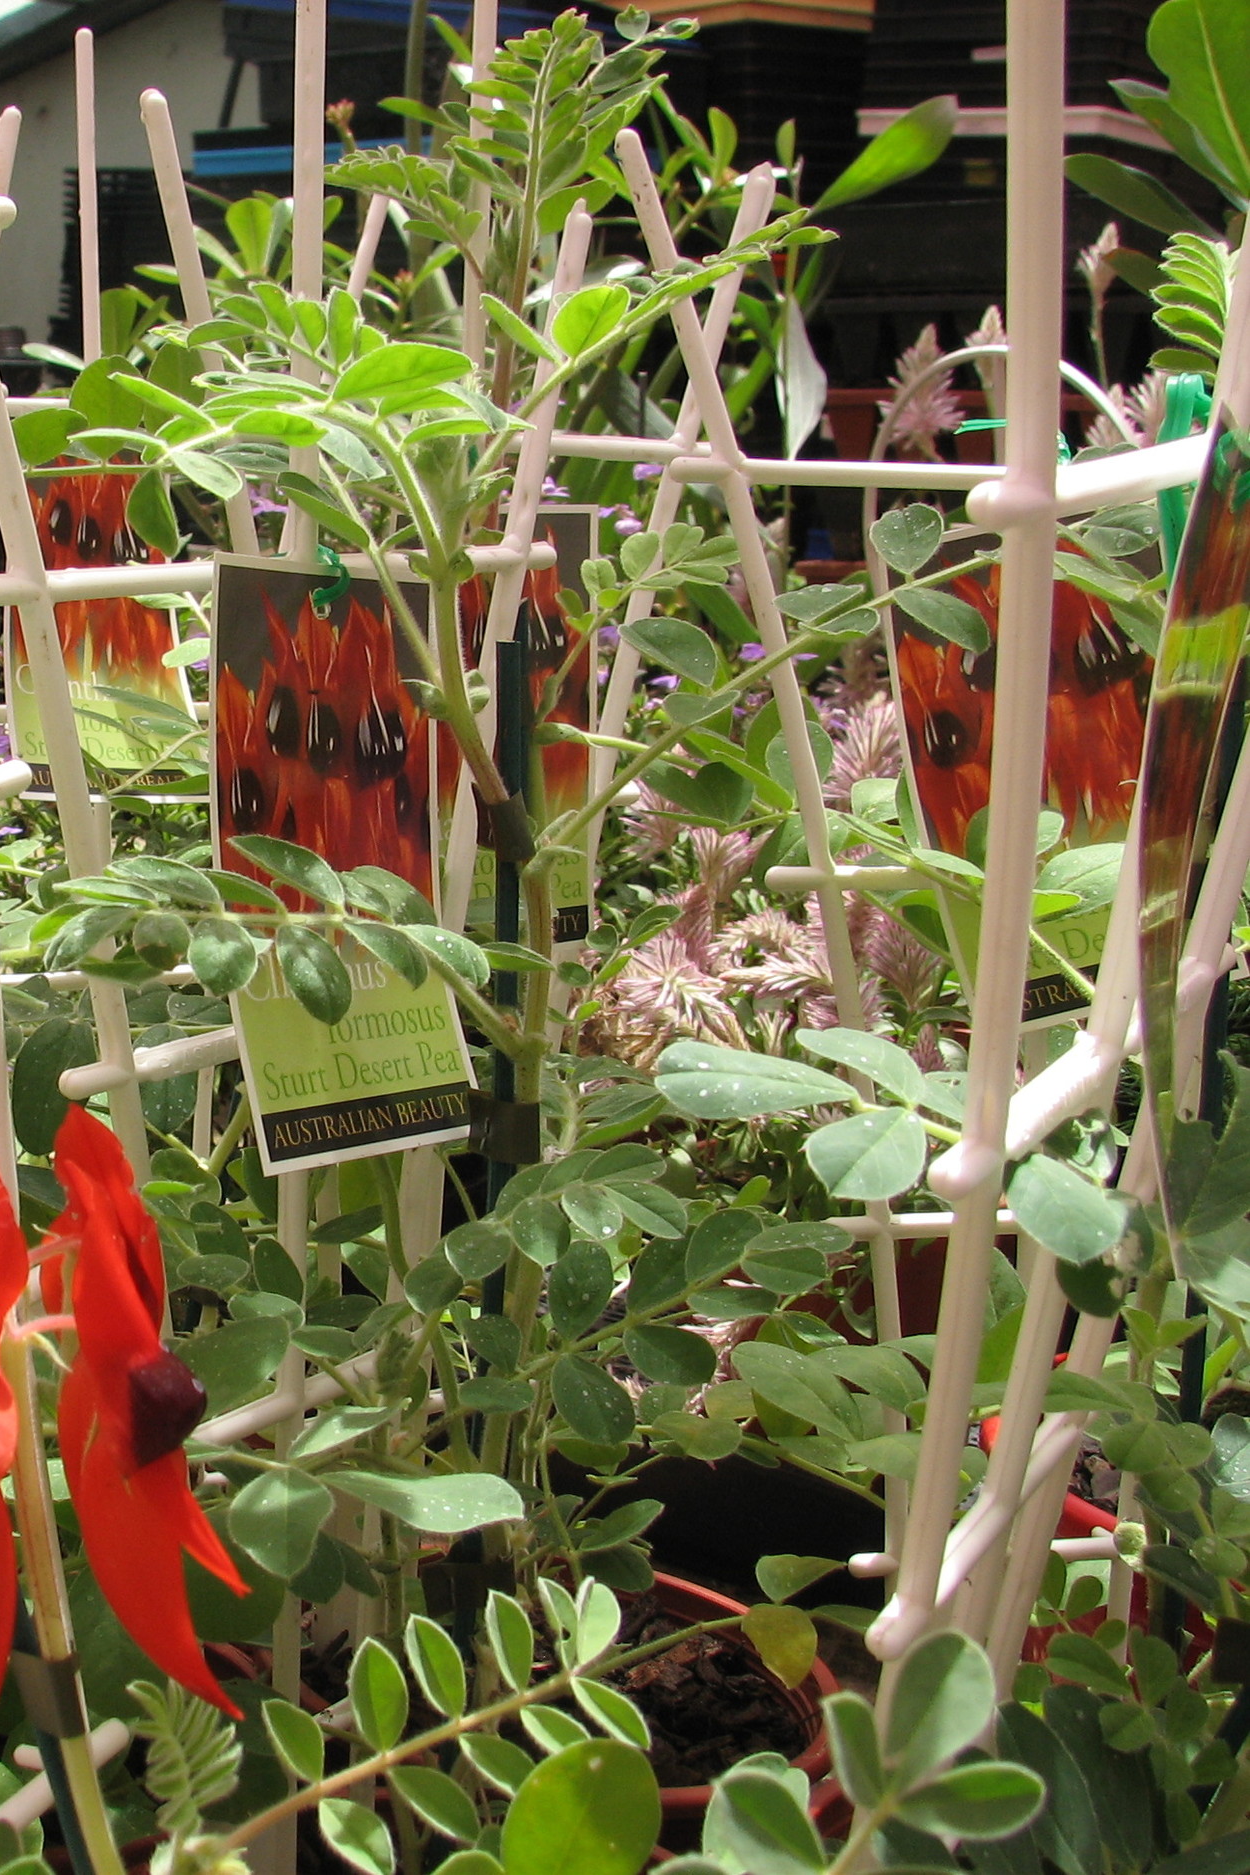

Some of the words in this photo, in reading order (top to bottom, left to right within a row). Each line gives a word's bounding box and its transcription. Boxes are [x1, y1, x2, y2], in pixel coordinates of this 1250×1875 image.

[262, 1061, 330, 1101] Sturt
[333, 1052, 414, 1091] Desert
[415, 1040, 461, 1077] Pea
[274, 1105, 394, 1149] AUSTRALIAN
